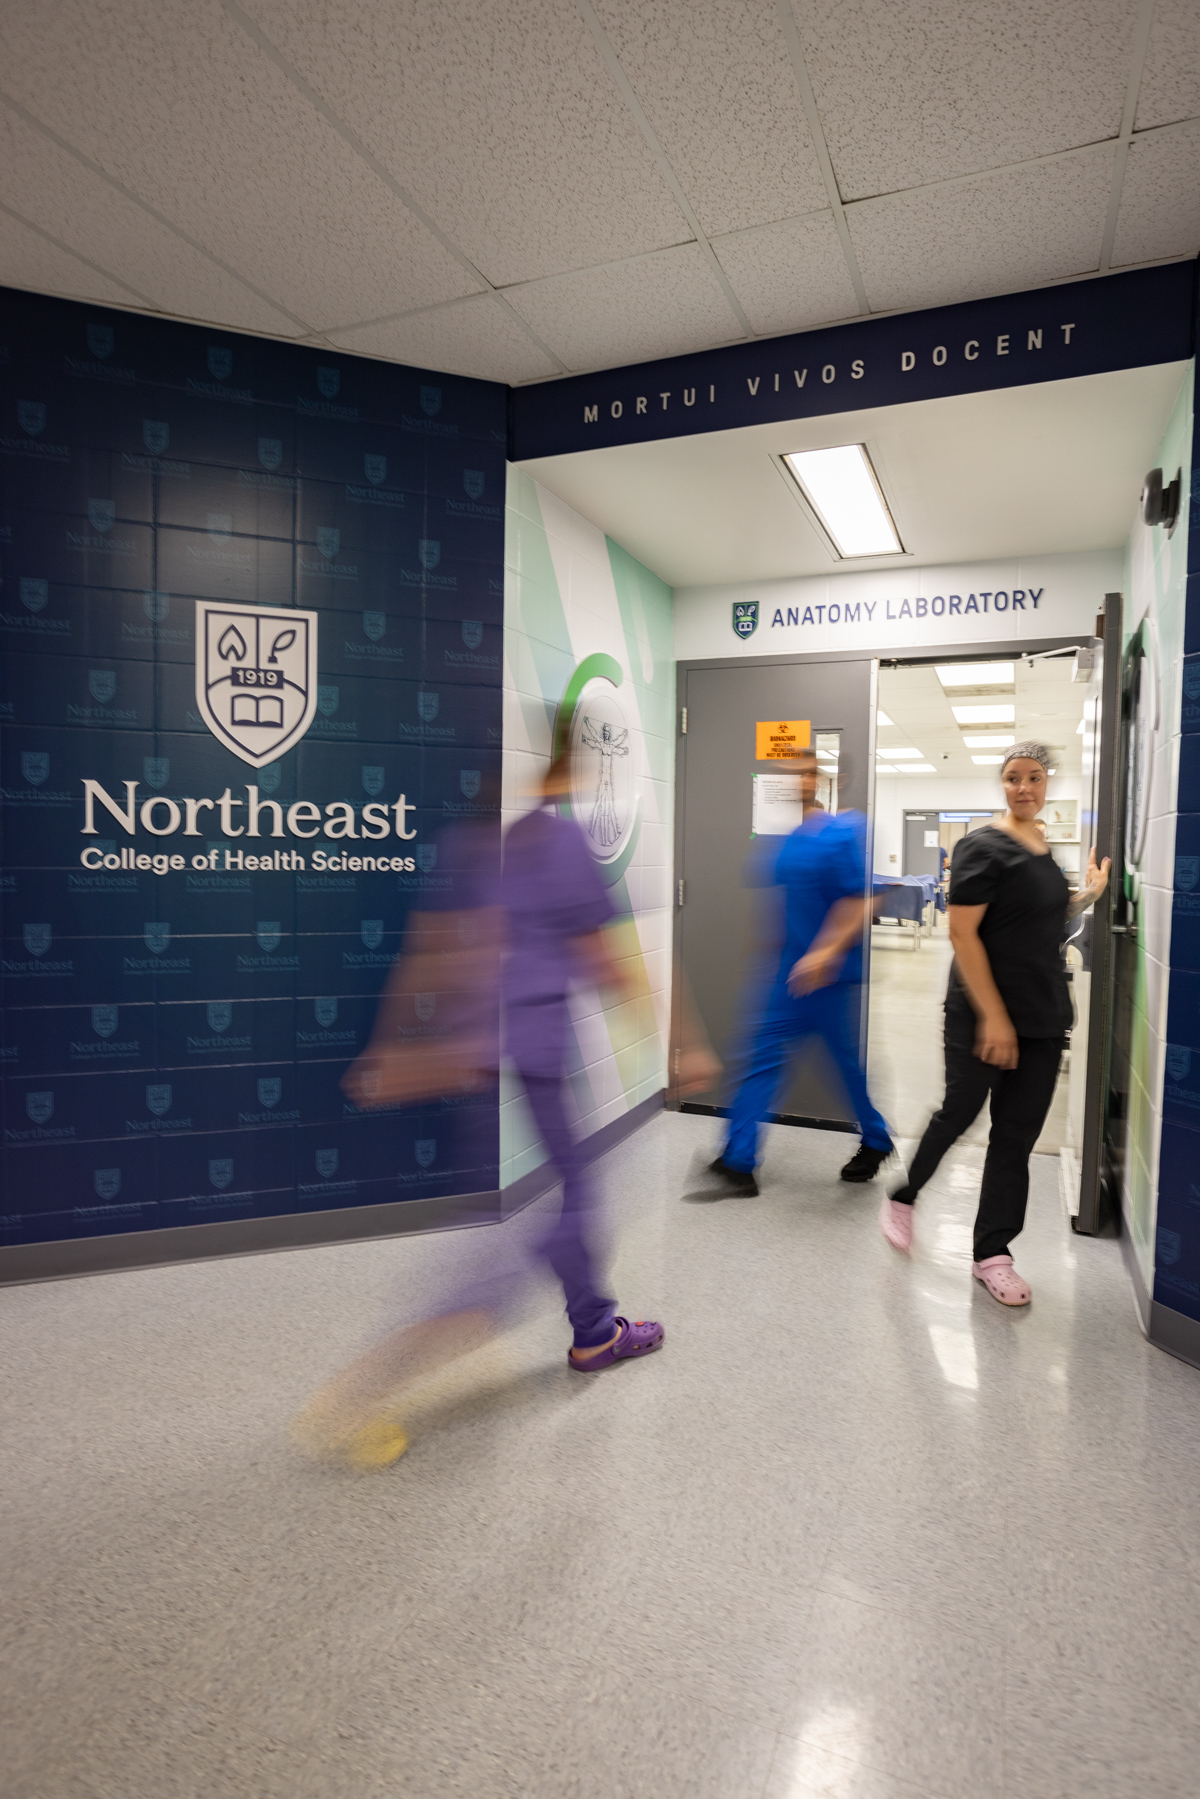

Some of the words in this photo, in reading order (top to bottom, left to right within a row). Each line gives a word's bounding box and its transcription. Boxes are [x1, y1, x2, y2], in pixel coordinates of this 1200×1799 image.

[583, 384, 715, 424] MORTUI
[747, 359, 864, 396] VIVOS
[901, 323, 1076, 372] DOCENT
[298, 396, 358, 417] Northeast
[401, 414, 458, 434] Northeast
[346, 484, 404, 502] Northeast
[445, 498, 500, 516] Northeast
[65, 530, 136, 551] Northeast
[298, 558, 358, 575] Northeast
[400, 568, 457, 586] Northeast
[771, 601, 877, 628] ANATOMY
[886, 588, 1044, 620] LABORATORY
[0, 612, 71, 630] Northeast
[121, 622, 189, 640] Northeast
[344, 641, 404, 658] Northeast
[444, 649, 499, 667] Northeast
[236, 669, 278, 686] 1919
[66, 703, 138, 720] Northeast
[400, 722, 456, 737] Northeast
[0, 787, 71, 801] Northeast
[80, 778, 418, 840] Northeast
[80, 847, 185, 875] College
[191, 849, 218, 871] of
[224, 850, 305, 871] Health
[311, 850, 416, 872] Sciences
[67, 874, 138, 886] Northeast
[186, 874, 252, 887] Northeast
[296, 875, 356, 887] Northeast
[398, 875, 453, 887] Northeast
[1, 959, 73, 972] Northeast
[123, 956, 191, 969] Northeast
[236, 954, 299, 967] Northeast
[342, 952, 400, 964] Northeast
[187, 1035, 252, 1049] Northeast
[296, 1029, 356, 1043] Northeast
[70, 1039, 140, 1053] Northeast
[343, 1101, 400, 1115] Northeast
[238, 1109, 300, 1124] Northeast
[126, 1117, 192, 1132] Northeast
[4, 1126, 76, 1141] Northeast
[297, 1179, 357, 1193] Northeast
